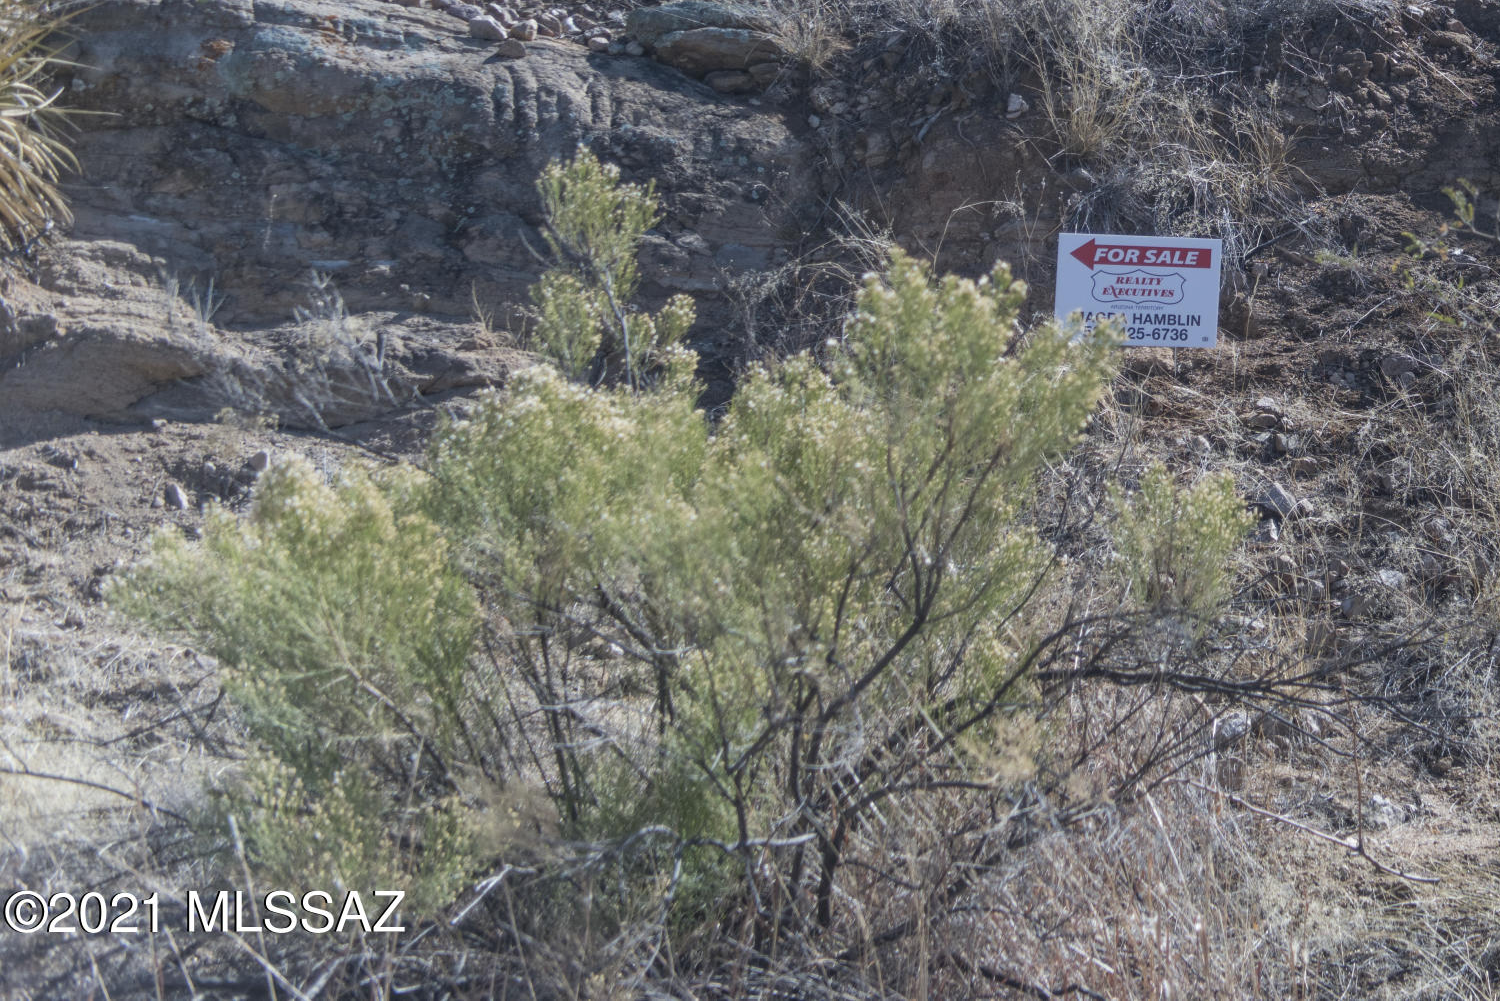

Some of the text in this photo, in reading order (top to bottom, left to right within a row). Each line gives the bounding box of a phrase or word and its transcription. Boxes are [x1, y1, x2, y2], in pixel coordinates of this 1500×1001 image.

[1094, 248, 1200, 265] FOR SALE
[1115, 276, 1164, 286] REALTY
[1102, 285, 1175, 298] EXECUTIVES
[1074, 311, 1201, 327] AGA HAMBLIN
